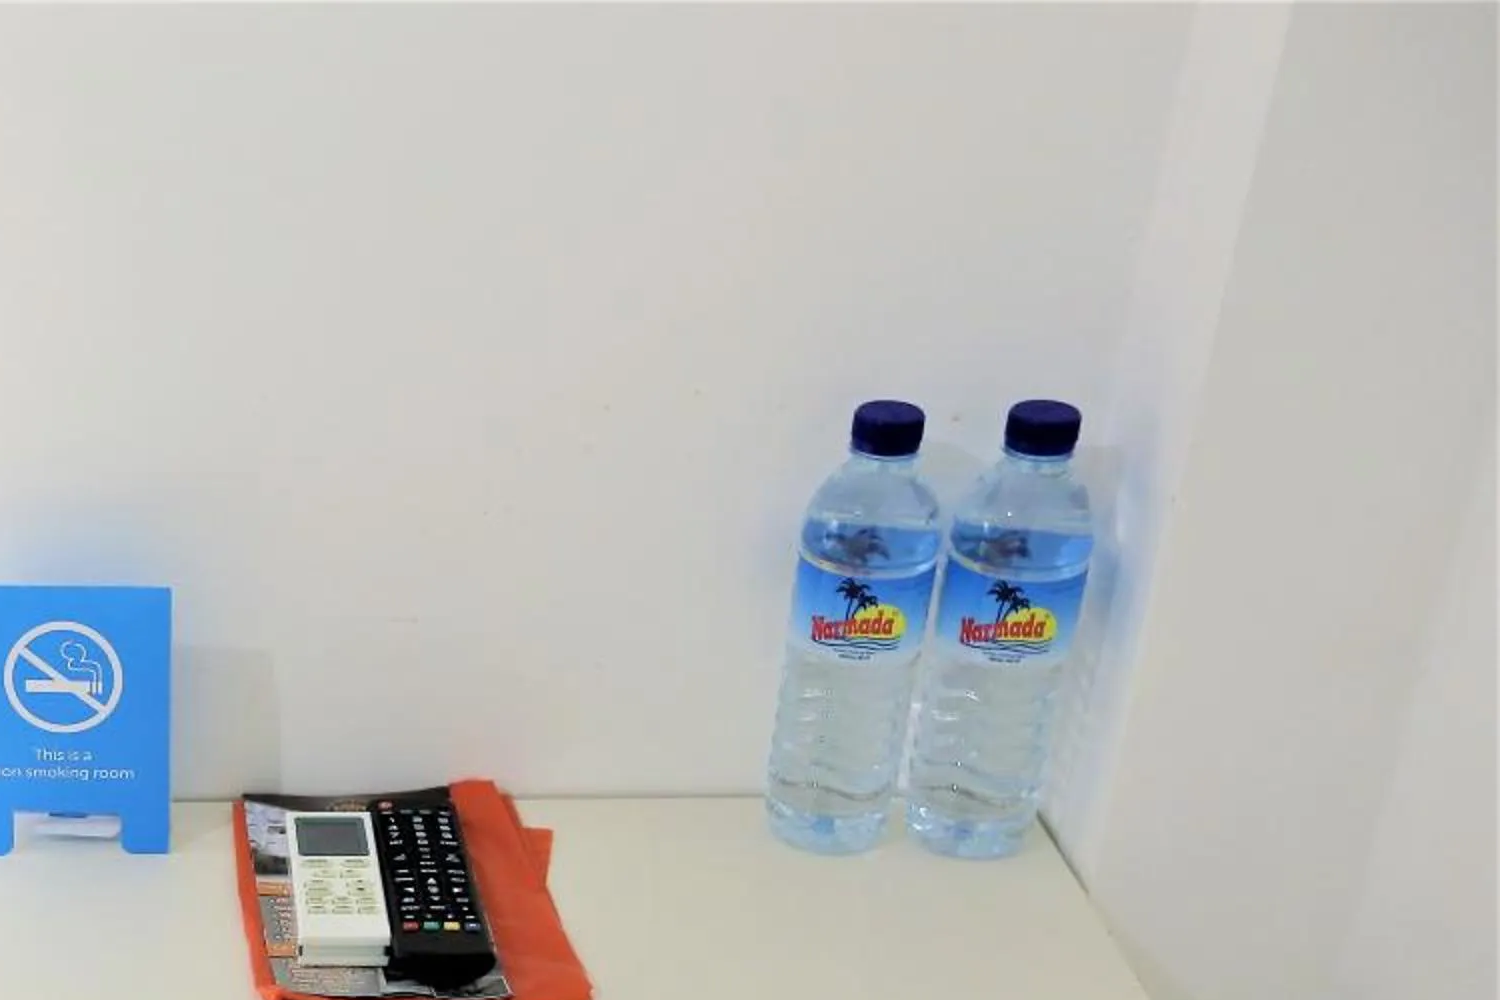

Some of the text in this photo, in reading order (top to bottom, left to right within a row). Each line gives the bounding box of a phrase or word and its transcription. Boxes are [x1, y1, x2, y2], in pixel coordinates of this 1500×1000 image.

[812, 609, 894, 641] Narmada
[961, 612, 1046, 644] Narmada
[36, 748, 94, 761] This is a
[25, 766, 89, 781] smoking
[93, 769, 135, 779] room
